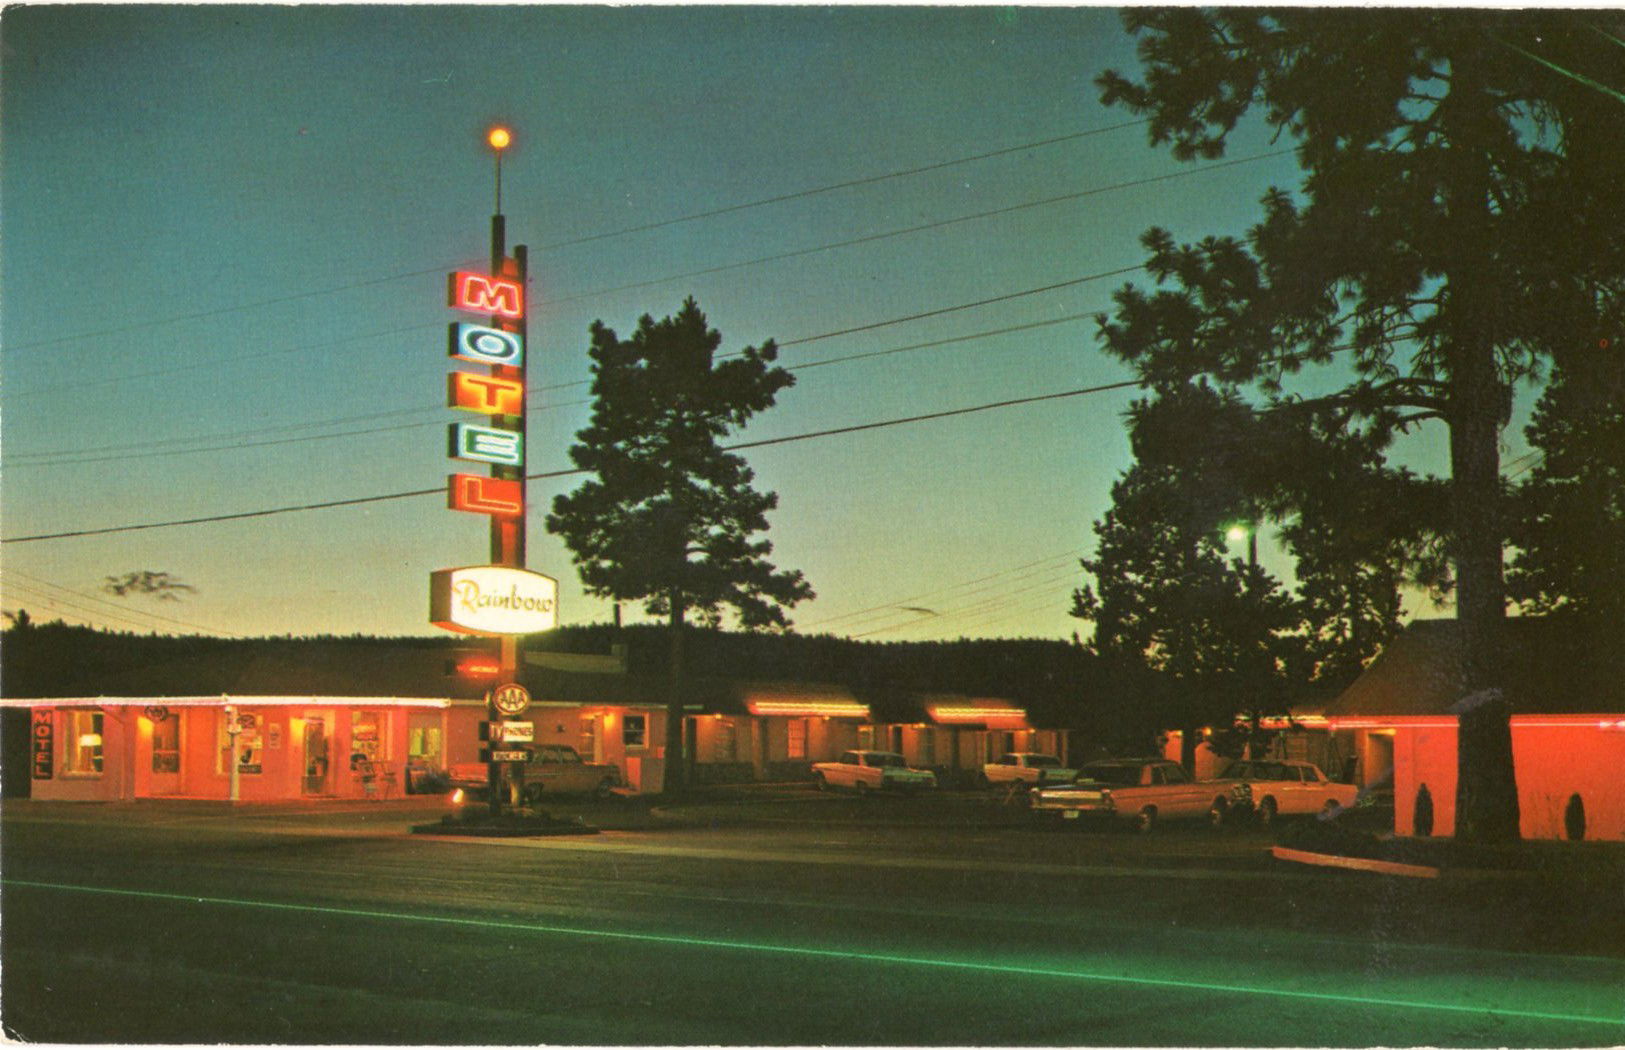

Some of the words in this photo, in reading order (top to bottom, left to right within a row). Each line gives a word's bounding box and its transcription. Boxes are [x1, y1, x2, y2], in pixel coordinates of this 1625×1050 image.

[462, 275, 523, 513] MOTEL
[452, 578, 553, 613] Rainbow
[499, 687, 527, 708] AAA
[34, 711, 51, 777] MOTEL
